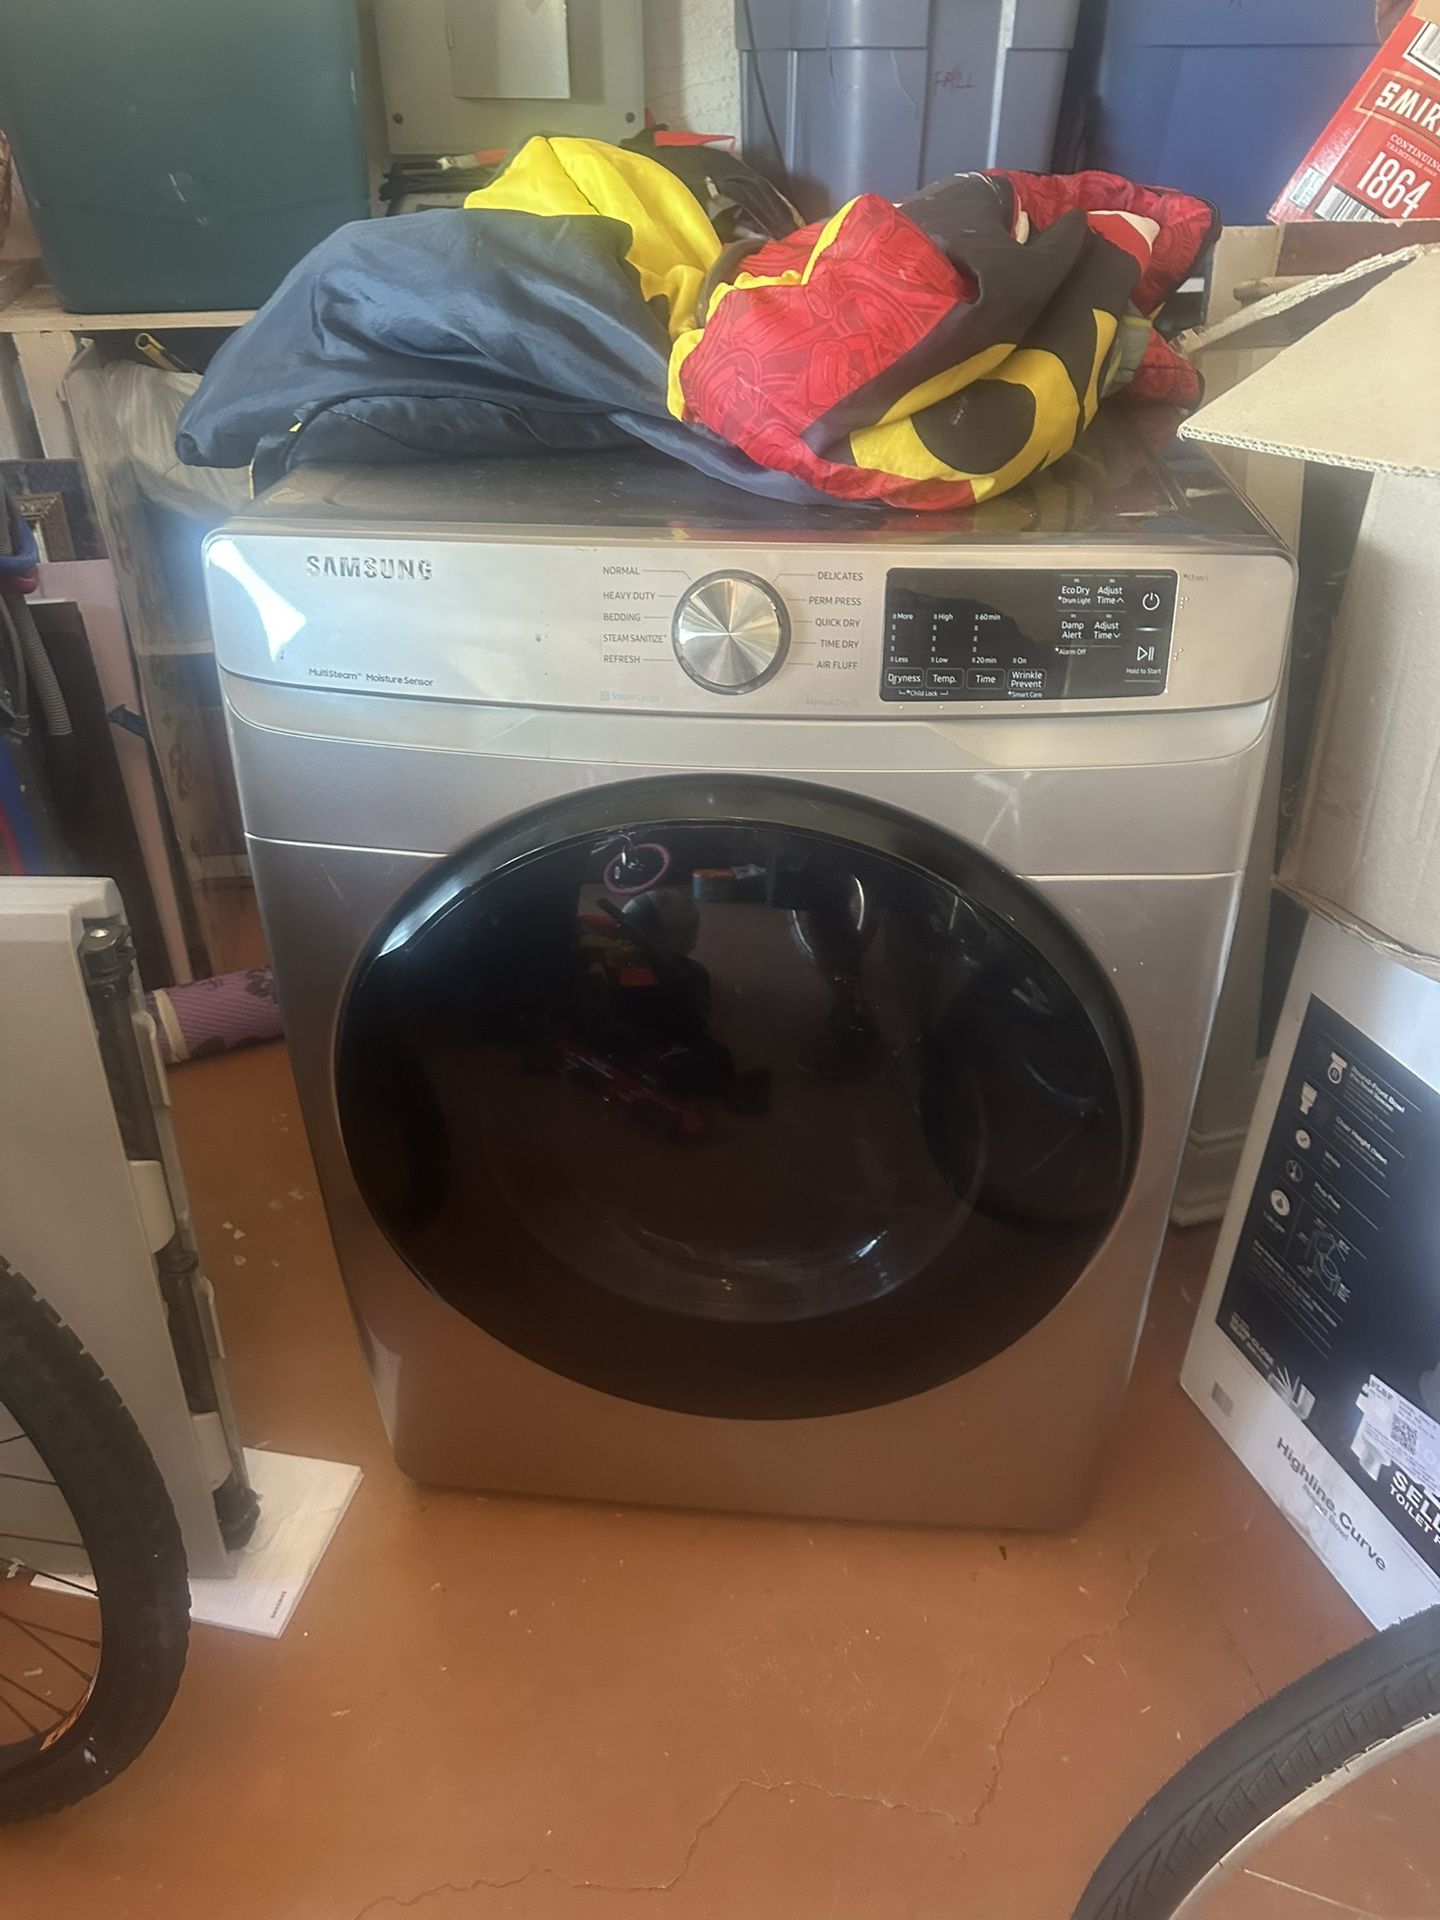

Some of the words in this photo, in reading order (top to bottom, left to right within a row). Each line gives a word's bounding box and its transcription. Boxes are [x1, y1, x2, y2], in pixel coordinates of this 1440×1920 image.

[1375, 81, 1440, 137] SMIR
[1356, 151, 1432, 219] 1864
[306, 555, 433, 581] SAMSUNG
[602, 566, 640, 576] NORMAL
[817, 571, 864, 581] DELICATES
[1061, 585, 1075, 594] Eco
[1076, 586, 1091, 595] Dry
[1097, 586, 1123, 596] Adjust
[602, 591, 631, 600] HEAVY
[632, 591, 656, 600] DUTY
[1097, 596, 1116, 604] Time
[808, 596, 833, 605] PERM
[834, 597, 862, 606] PRESS
[1077, 597, 1091, 605] Light
[602, 612, 641, 621] BEDDING
[897, 612, 914, 620] More
[938, 613, 954, 622] High
[815, 617, 841, 627] QUICK
[842, 618, 860, 627] DRY
[1061, 621, 1084, 630] Damp
[1094, 621, 1119, 631] Adjust
[603, 633, 629, 643] STEAM
[1061, 630, 1082, 639] Alert
[1094, 630, 1112, 639] Time
[820, 639, 841, 648] TIME
[842, 639, 860, 648] DRY
[603, 654, 640, 663] REFRESH
[894, 655, 909, 663] Less
[976, 656, 984, 664] 20
[1017, 656, 1027, 664] On
[816, 660, 831, 669] AIR
[832, 660, 859, 670] FLUFF
[365, 673, 403, 684] Moisture
[404, 676, 434, 687] Sensor
[888, 673, 921, 685] Dryness
[932, 674, 958, 685] Temp.
[976, 674, 997, 684] Time
[1011, 670, 1043, 680] Wrinkle
[1010, 679, 1042, 688] Prevent
[1390, 1484, 1433, 1533] TOILET
[1339, 1511, 1386, 1571] Curve
